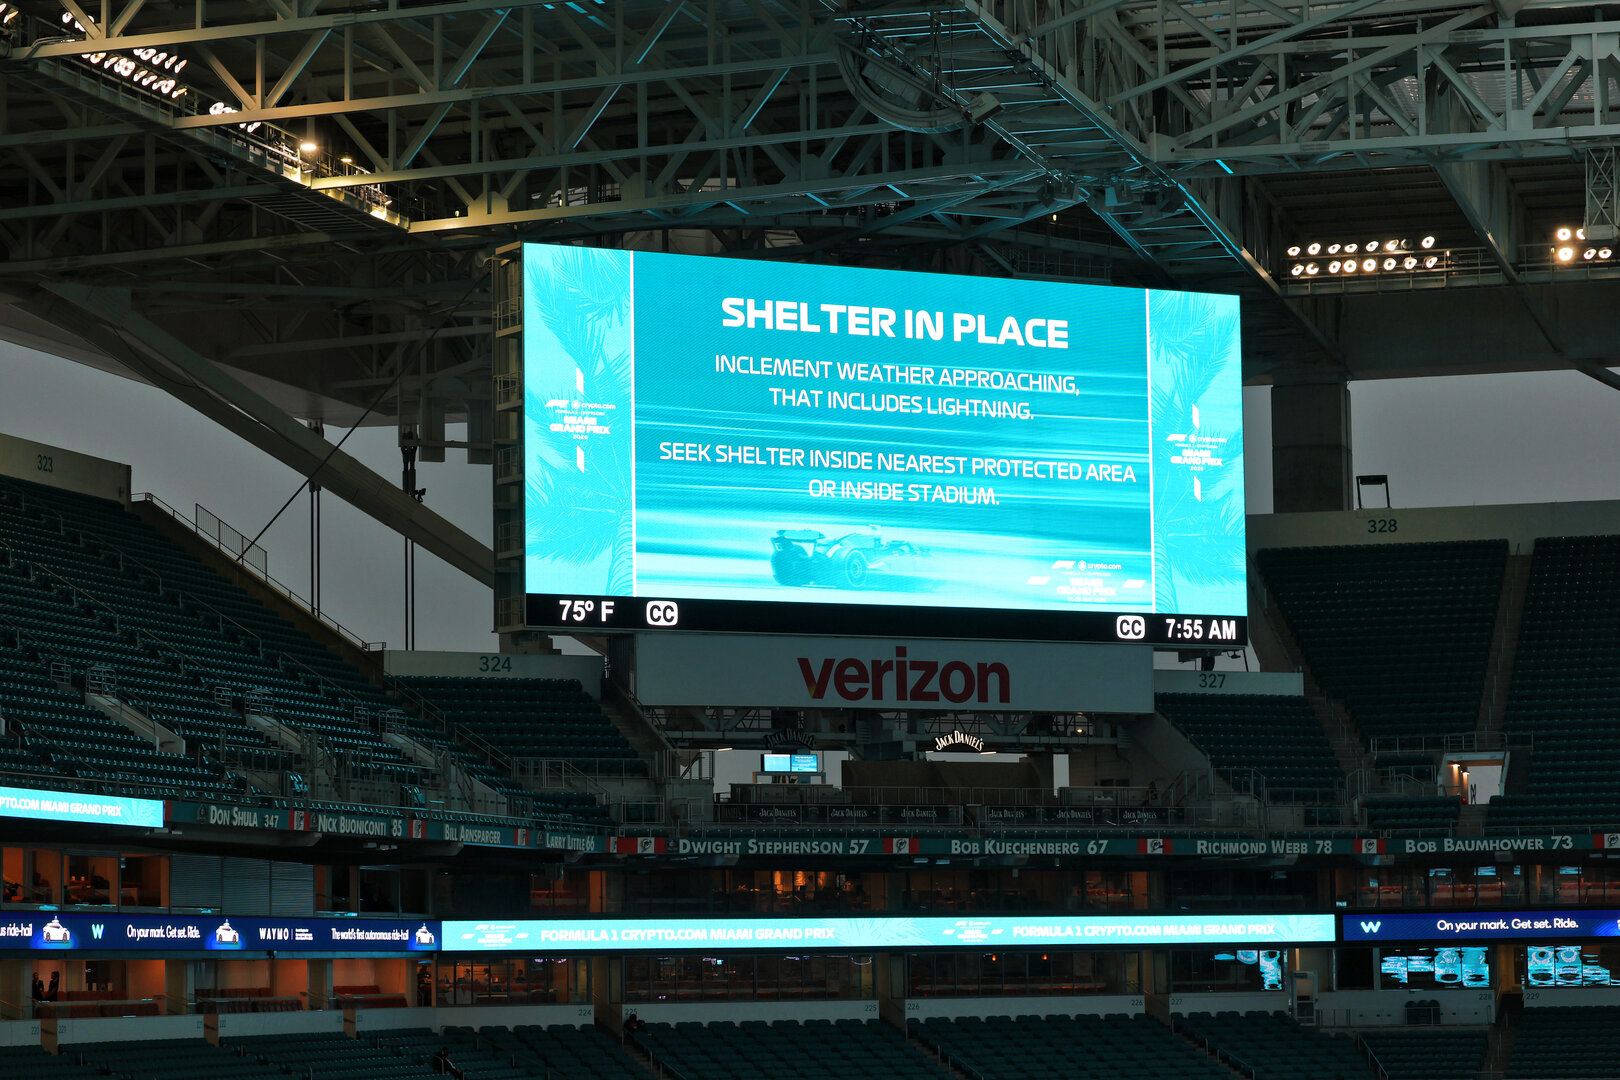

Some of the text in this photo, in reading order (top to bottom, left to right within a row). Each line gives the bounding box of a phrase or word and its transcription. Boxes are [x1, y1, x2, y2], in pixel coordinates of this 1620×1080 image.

[721, 297, 1069, 349] SHELTER IN PLACE
[715, 354, 1080, 396] INCLEMENT WEATHER APPROACHING,
[769, 387, 1035, 420] THAT INCLUDES LIGHTNING.
[549, 423, 611, 435] GRAND PRIX
[37, 454, 53, 472] 323
[659, 442, 1137, 483] SEEK SHELTER INSIDE NEAREST PROTECTED AREA
[808, 479, 1000, 506] OR INSIDE STADIUM.
[1367, 519, 1398, 533] 328
[1088, 562, 1122, 570] crypto.com
[601, 601, 615, 622] F
[649, 604, 675, 622] CC
[1119, 619, 1142, 636] CC
[1165, 618, 1237, 640] 7:55 AM
[479, 656, 513, 672] 324
[797, 646, 1011, 704] verizon
[1199, 673, 1226, 688] 327
[935, 730, 985, 752] JACK DANIEL'S
[41, 800, 69, 813] MIAMI
[70, 802, 101, 816] GRAND
[102, 804, 122, 817] PRIX
[264, 814, 279, 828] 347
[392, 819, 403, 837] 85
[585, 835, 595, 851] 66
[849, 839, 870, 854] 57
[1087, 839, 1109, 854] 67
[1315, 840, 1332, 854] 78
[1550, 835, 1574, 850] 73
[7, 923, 33, 937] ride-hail
[92, 924, 105, 939] W
[126, 925, 201, 942] On your mark. Get set. Ride.
[259, 927, 289, 940] WAYMO
[1013, 923, 1275, 937] FORMULA 1 CRYPTO.COM MIAMI GRAND PRIX
[1361, 921, 1381, 933] W
[1437, 918, 1579, 934] On your mark. Get set. Ride.
[331, 928, 340, 940] The
[541, 927, 836, 941] FORMULA 1 CRYPTO.COM MIAMI GRAND PRIX
[1171, 998, 1183, 1006] 227
[1526, 992, 1540, 1000] 229
[578, 1009, 591, 1017] 224
[624, 1008, 638, 1016] 225
[864, 1004, 877, 1012] 225
[907, 1002, 920, 1010] 226
